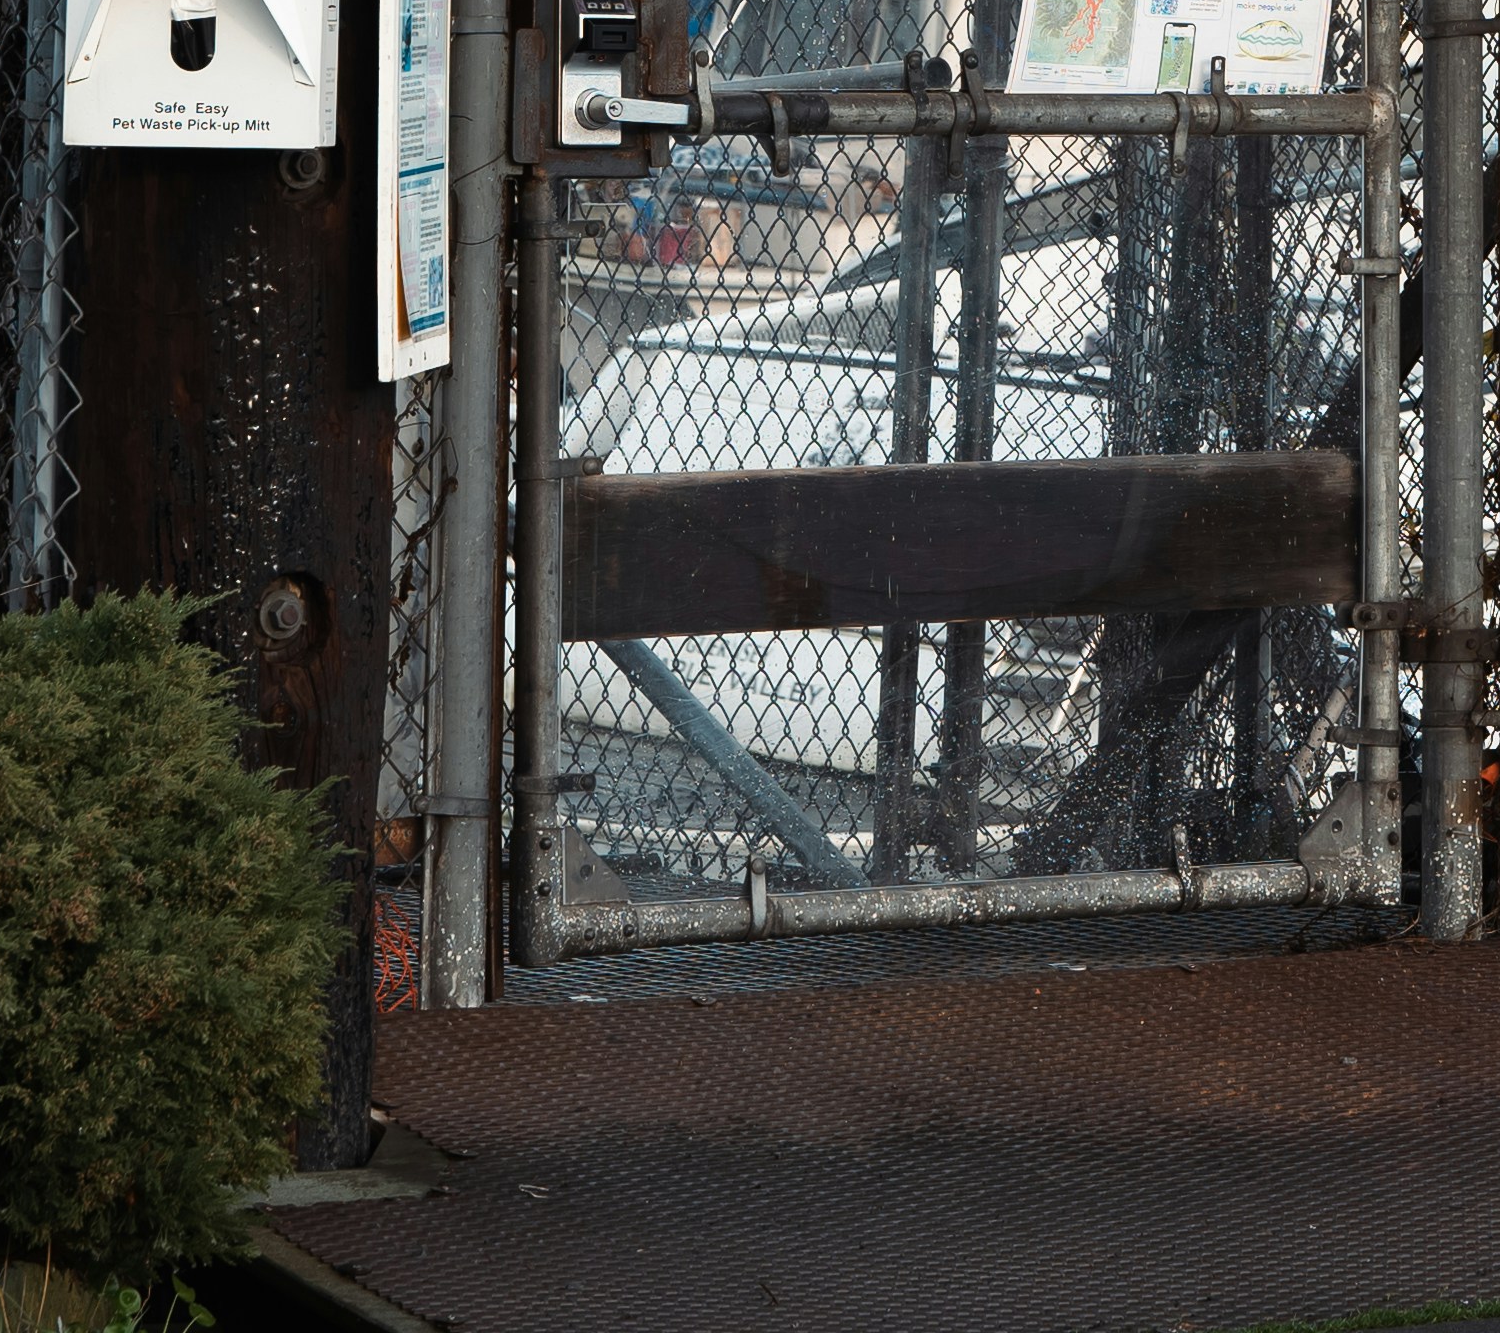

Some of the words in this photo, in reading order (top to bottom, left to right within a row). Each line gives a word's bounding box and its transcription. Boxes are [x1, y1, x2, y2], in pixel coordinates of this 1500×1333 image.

[155, 102, 186, 114] Safe
[196, 102, 229, 117] Easy
[113, 117, 135, 130] Pet
[140, 118, 182, 130] Waste
[188, 119, 240, 133] Pick-up
[246, 120, 270, 131] Mitt
